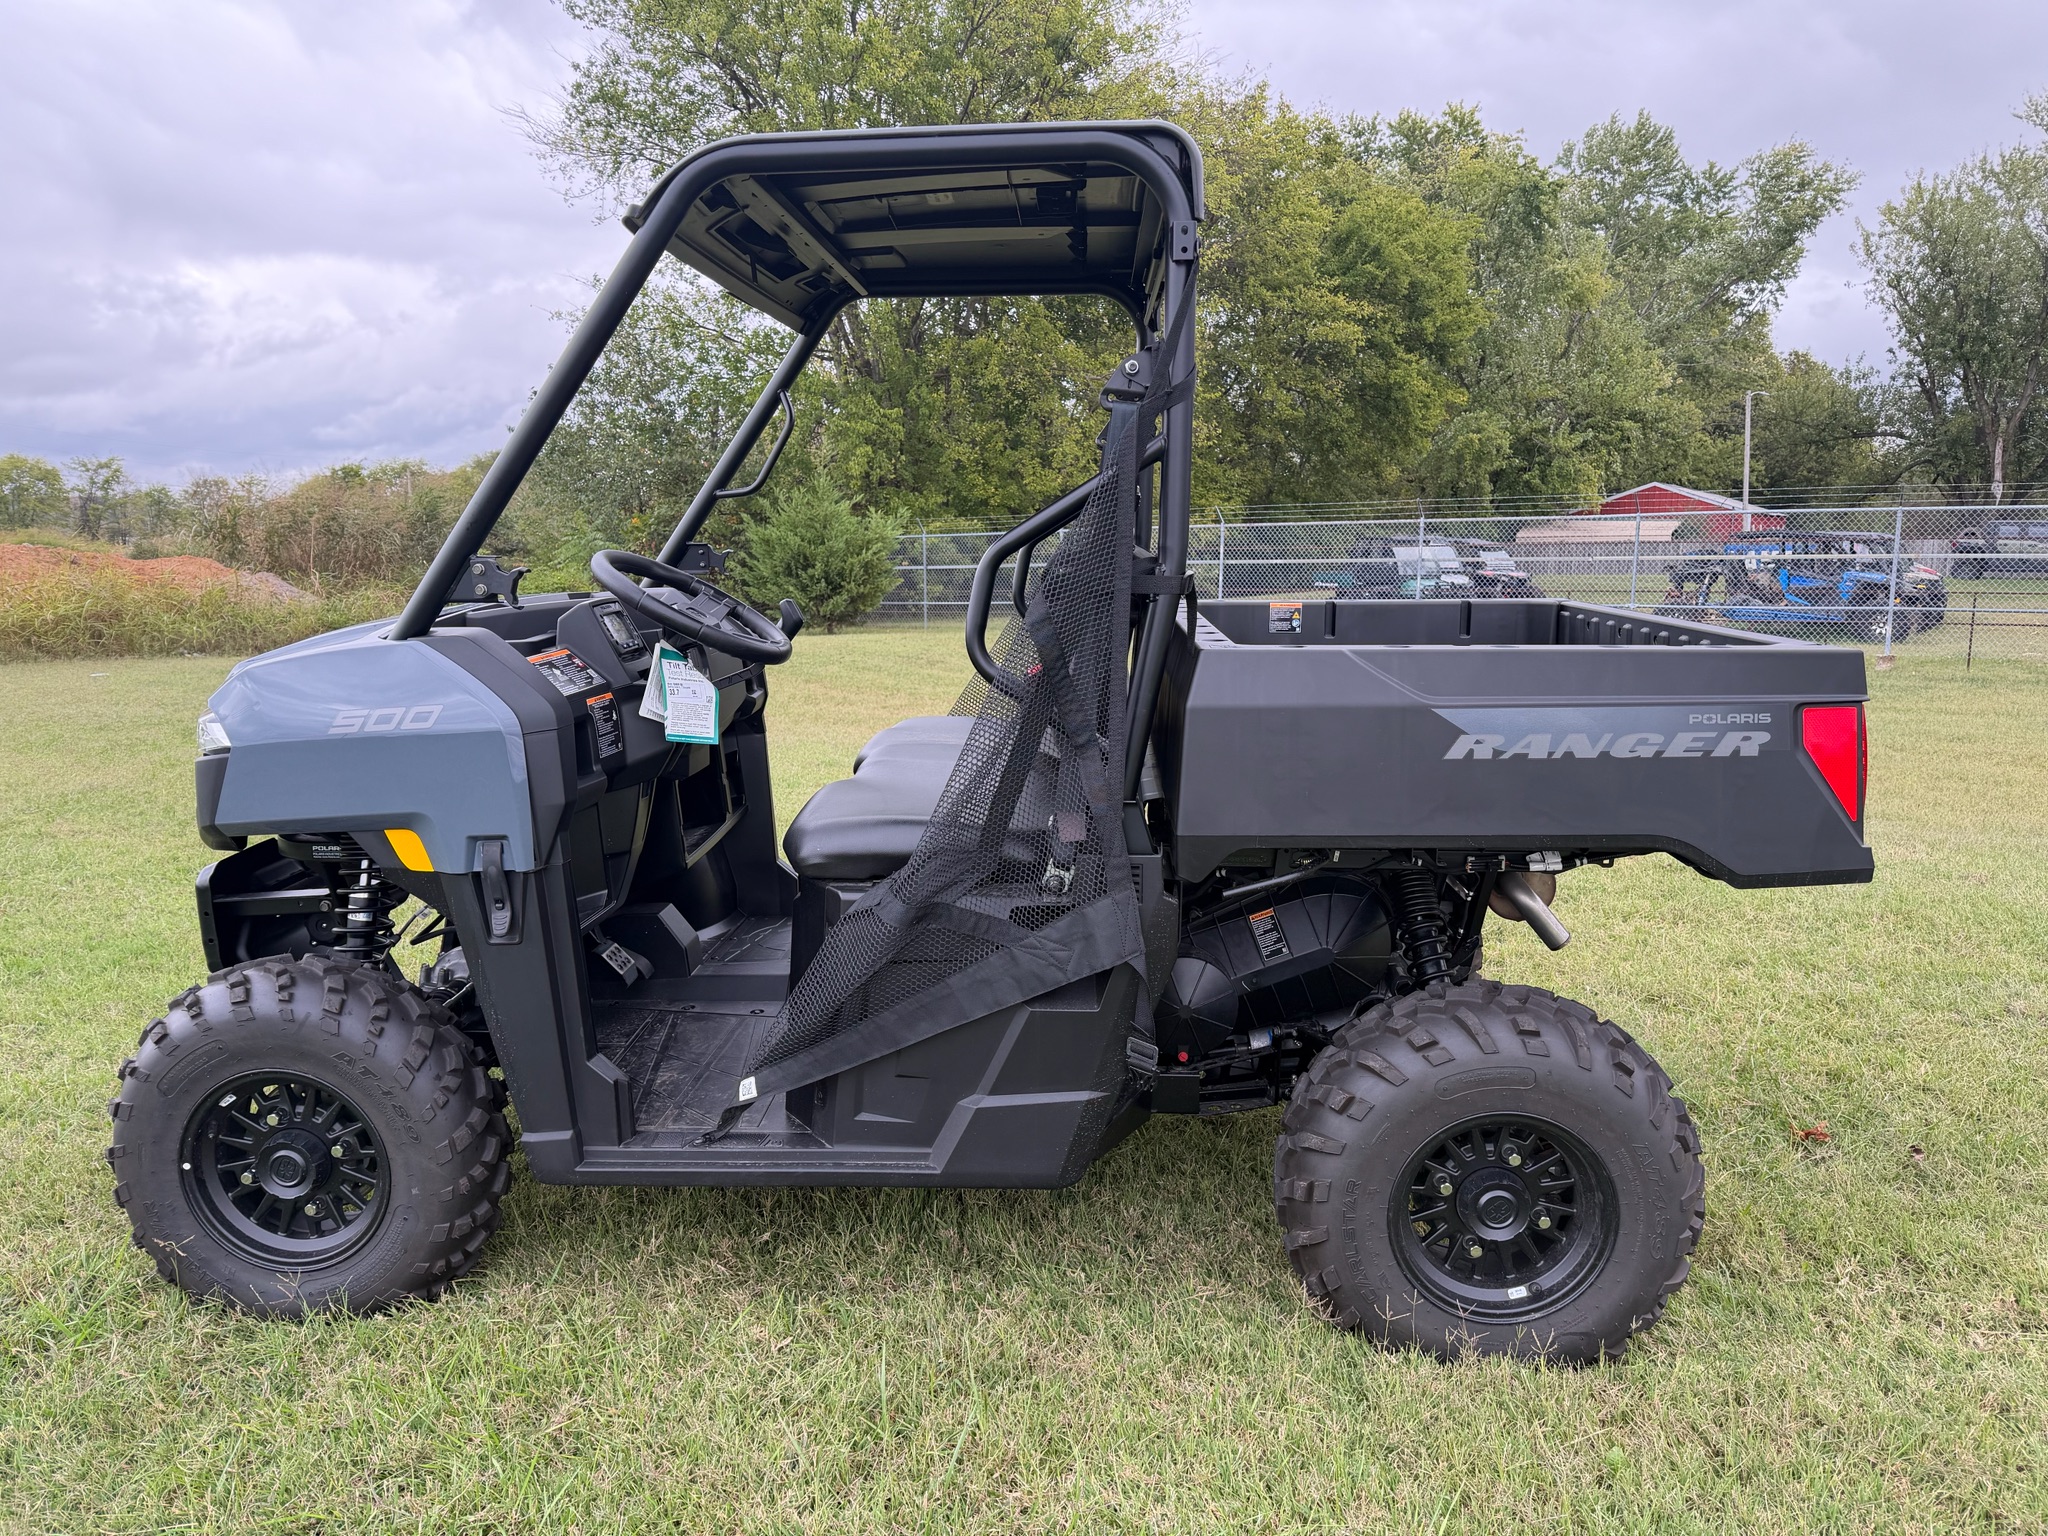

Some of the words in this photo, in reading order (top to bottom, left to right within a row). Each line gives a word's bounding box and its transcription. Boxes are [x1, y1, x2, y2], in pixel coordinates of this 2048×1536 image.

[666, 661, 681, 670] Tilt
[328, 704, 443, 734] 500
[1689, 713, 1771, 724] POLARIS
[1443, 731, 1771, 760] RANGER
